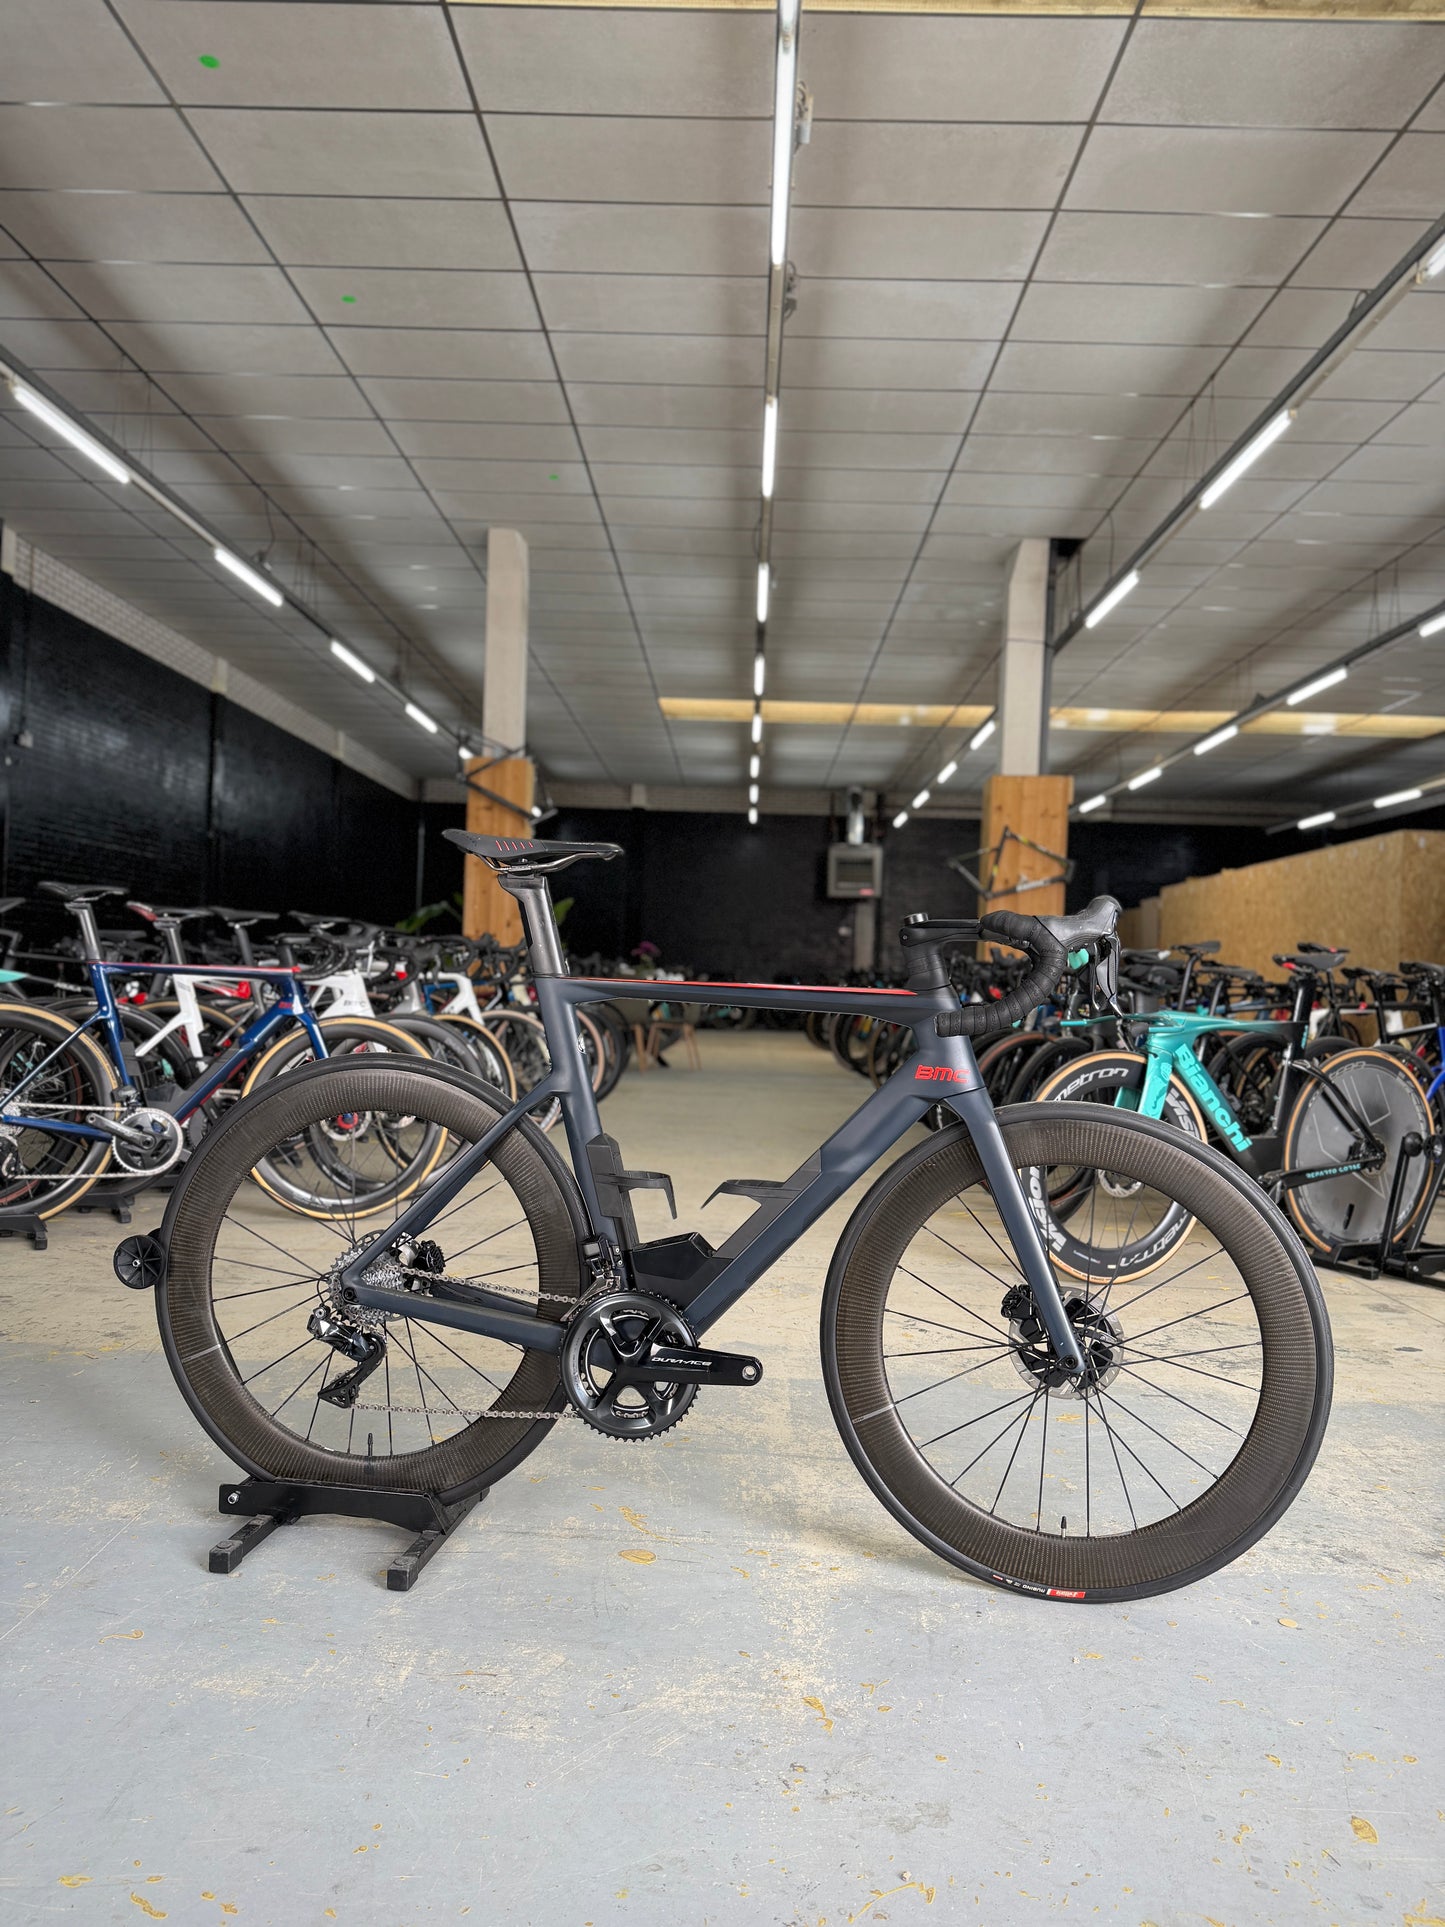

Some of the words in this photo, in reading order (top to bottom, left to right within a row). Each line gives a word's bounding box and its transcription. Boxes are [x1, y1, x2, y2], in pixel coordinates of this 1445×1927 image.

[914, 1064, 971, 1084] BMC
[1175, 1043, 1253, 1152] Bianchi
[1022, 1584, 1046, 1594] RUBINO
